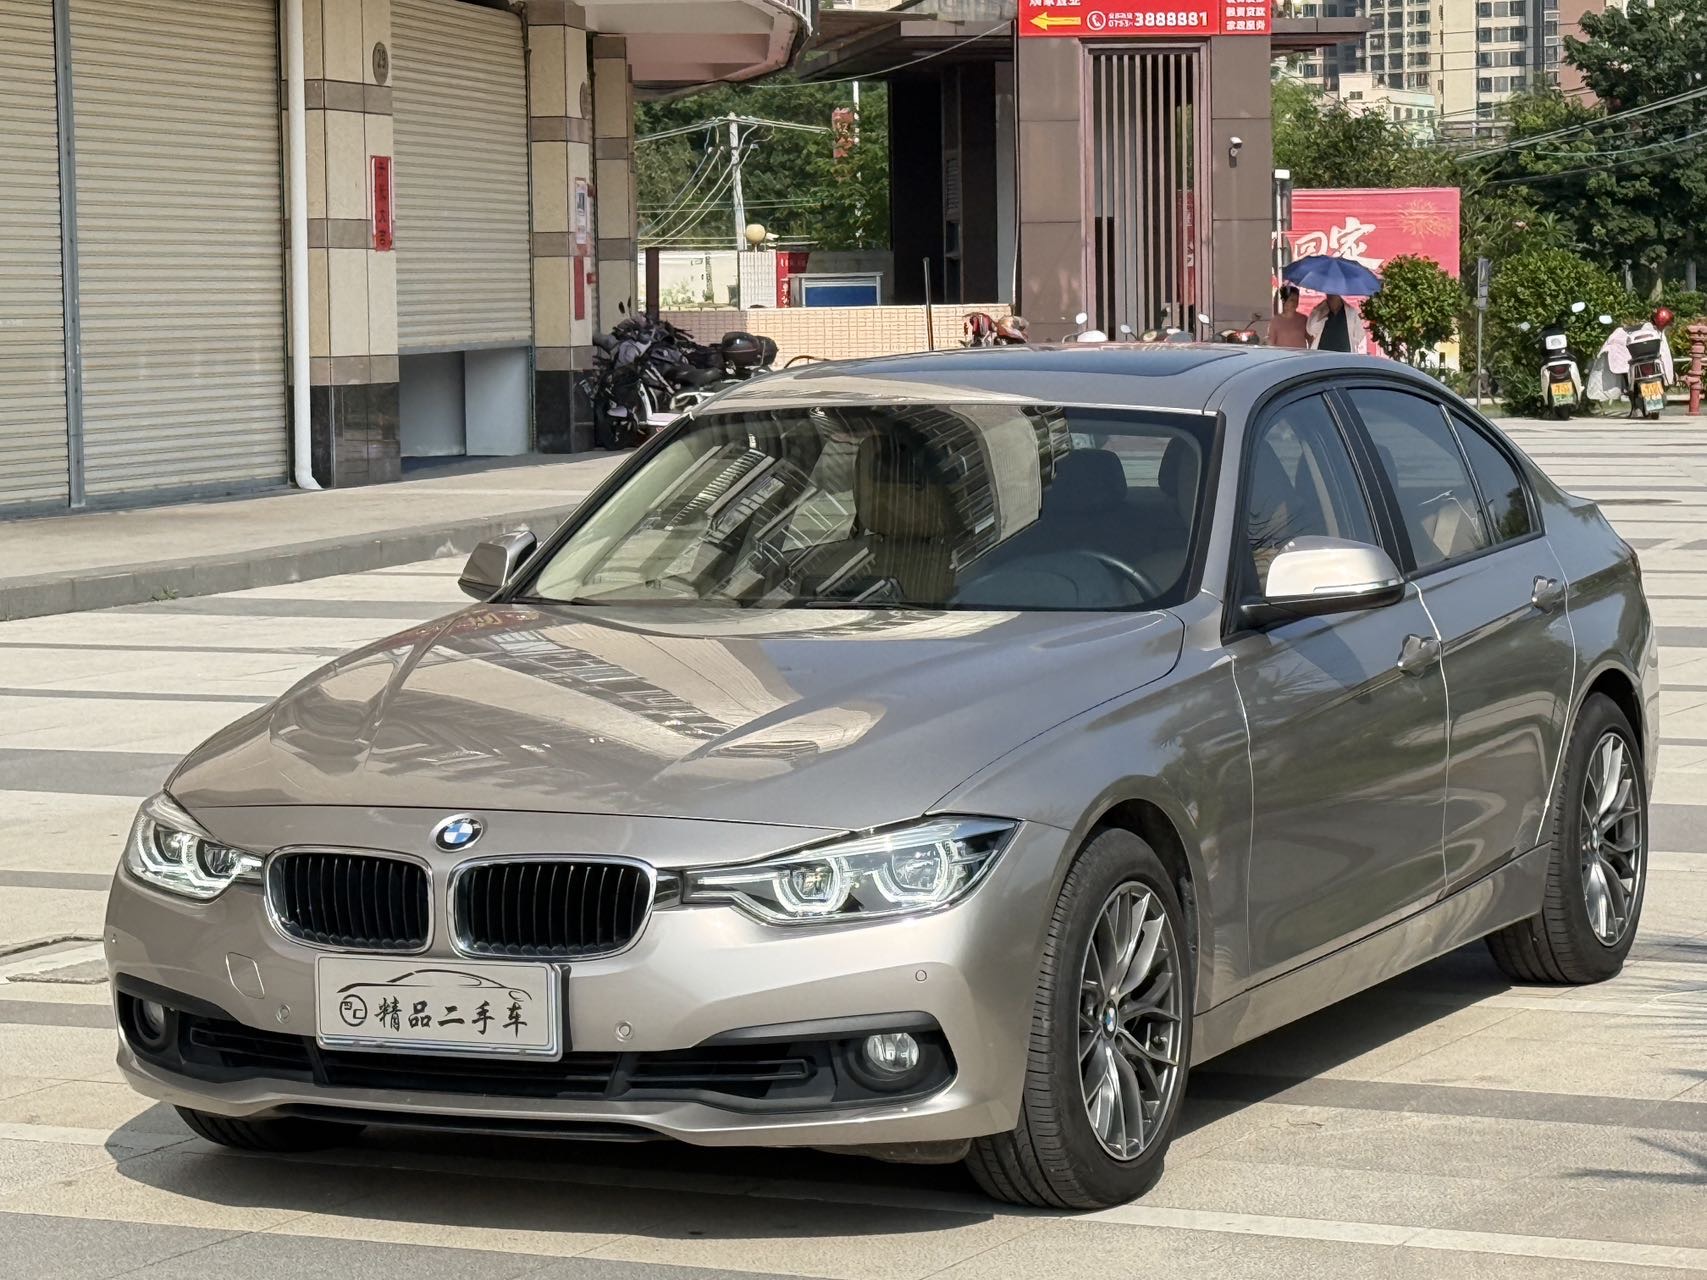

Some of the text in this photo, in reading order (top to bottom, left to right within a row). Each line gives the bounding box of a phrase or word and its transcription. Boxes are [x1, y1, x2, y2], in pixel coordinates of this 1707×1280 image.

[1134, 11, 1208, 26] 3888881
[374, 995, 528, 1038] 精品二手车
